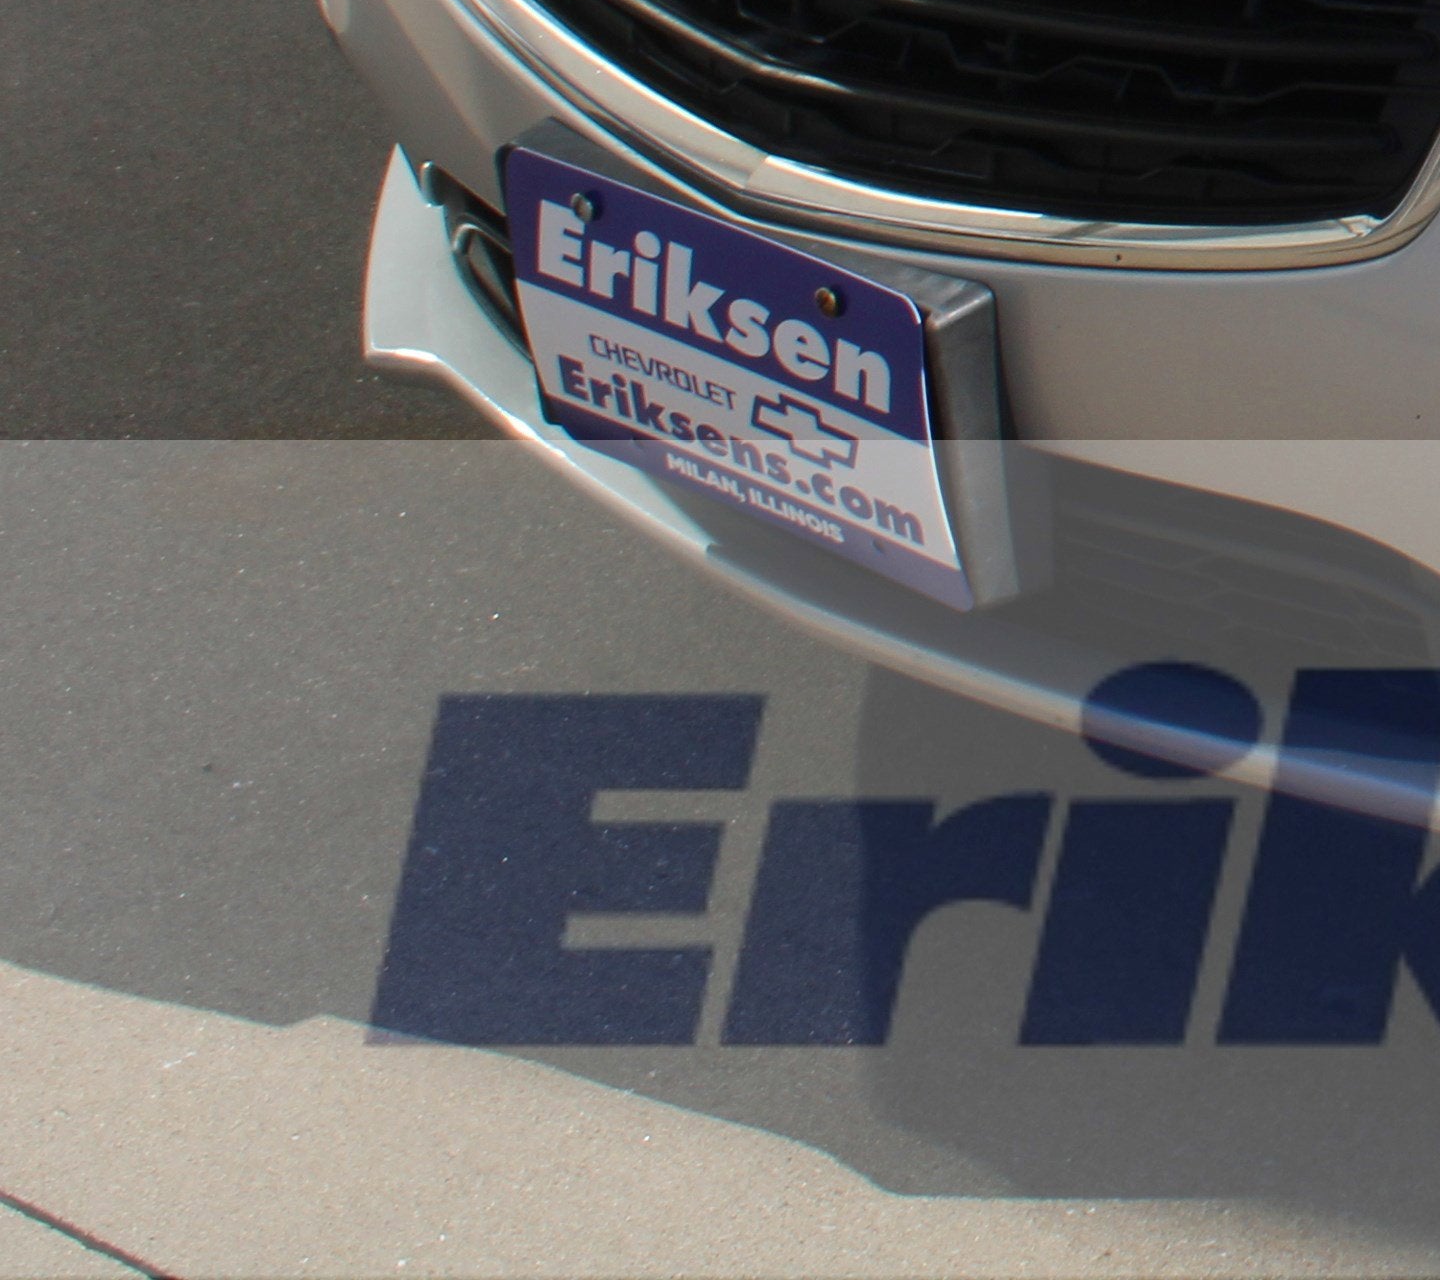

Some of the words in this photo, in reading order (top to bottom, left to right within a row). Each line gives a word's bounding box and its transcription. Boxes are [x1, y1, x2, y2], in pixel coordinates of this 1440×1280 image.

[537, 198, 893, 415] Eriksen
[589, 333, 738, 411] CHEVROLET
[557, 355, 925, 547] Eriksens.com
[666, 452, 747, 504] MILAN,
[748, 486, 844, 545] ILLINOIS
